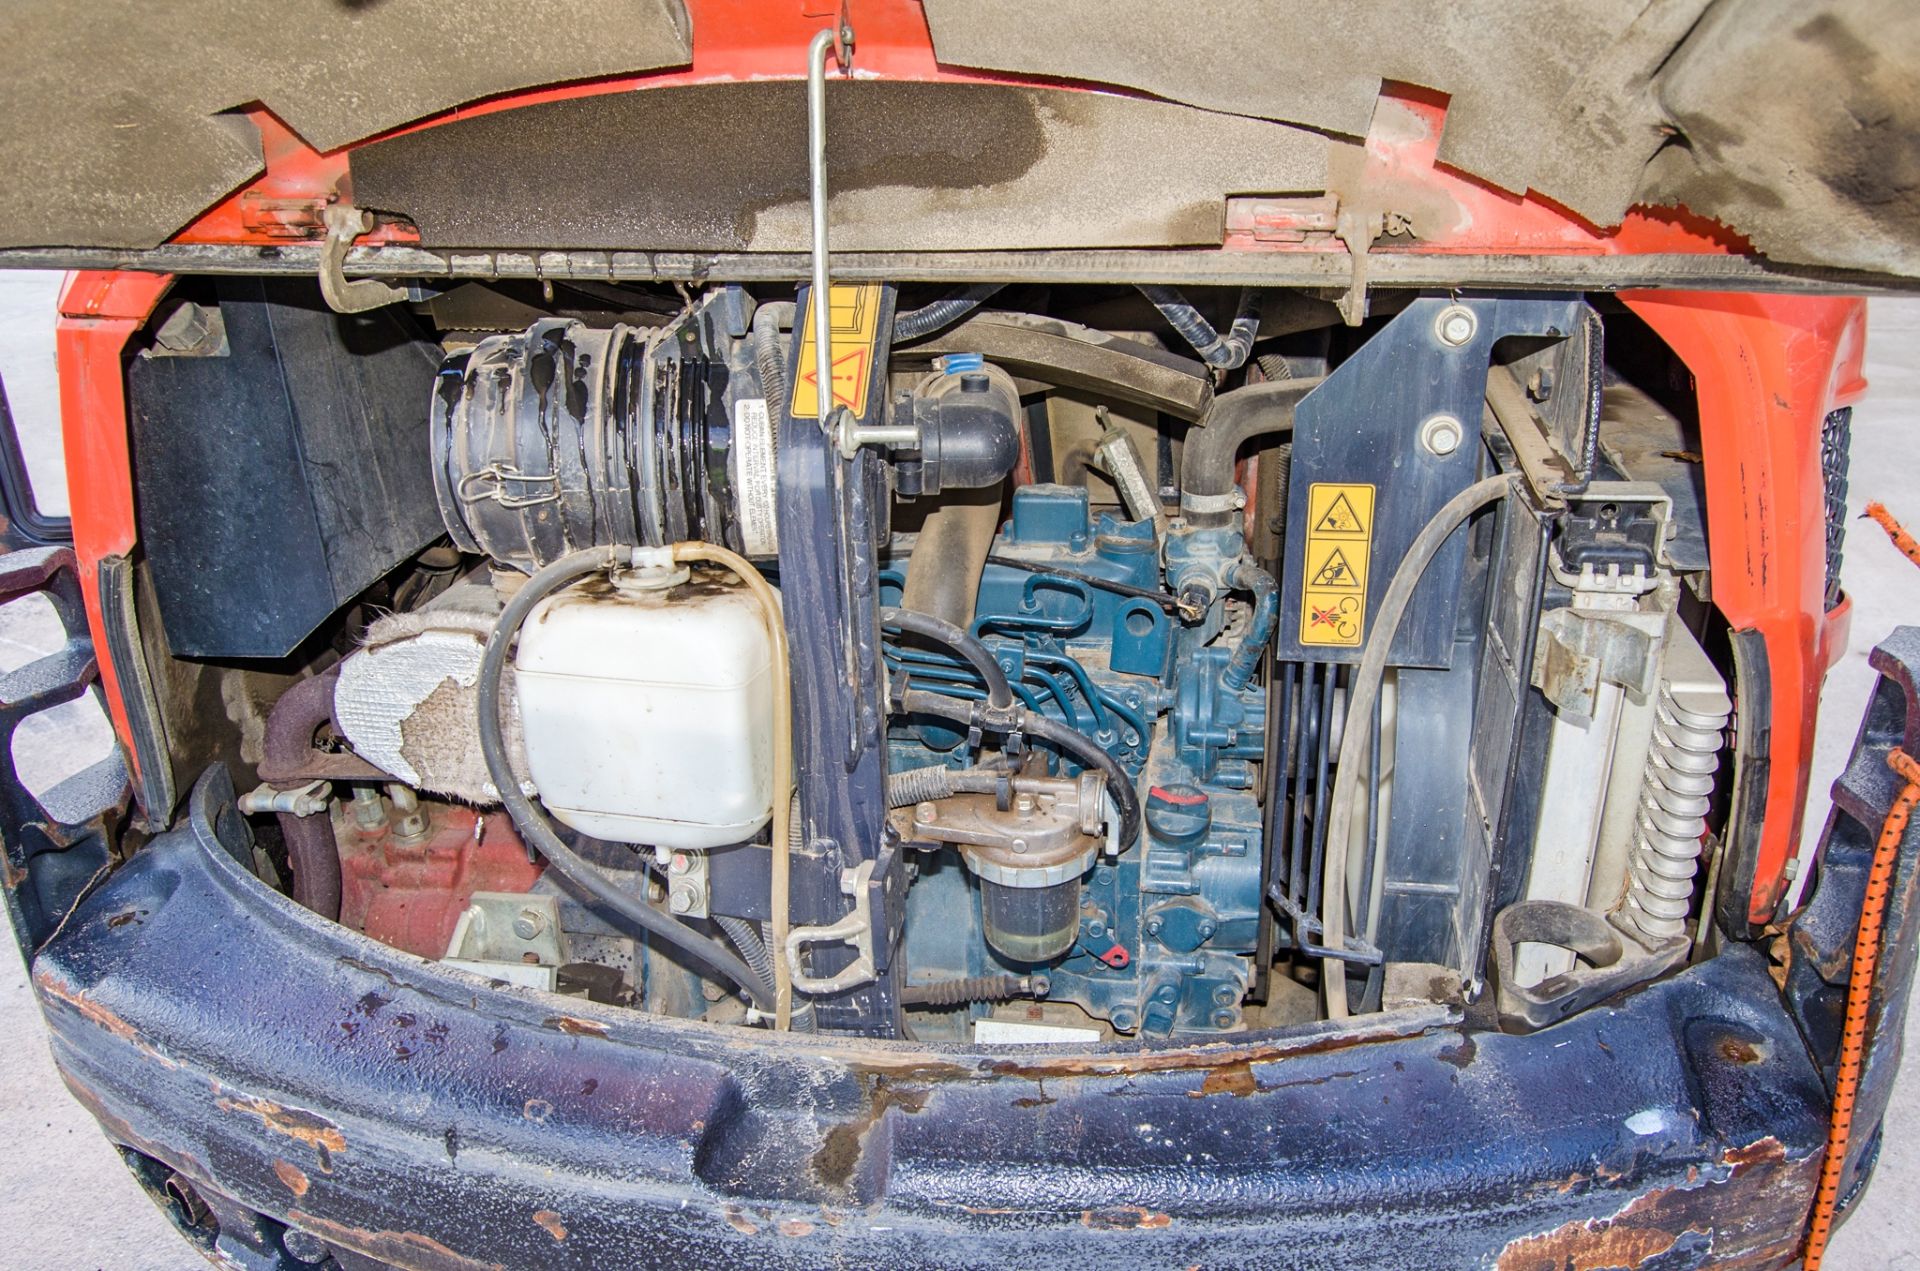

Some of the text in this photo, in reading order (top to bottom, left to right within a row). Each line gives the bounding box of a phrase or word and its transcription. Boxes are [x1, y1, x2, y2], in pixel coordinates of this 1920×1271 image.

[745, 441, 753, 476] OPERATE
[746, 478, 755, 507] WITHOUT
[749, 508, 760, 535] ELEMENT
